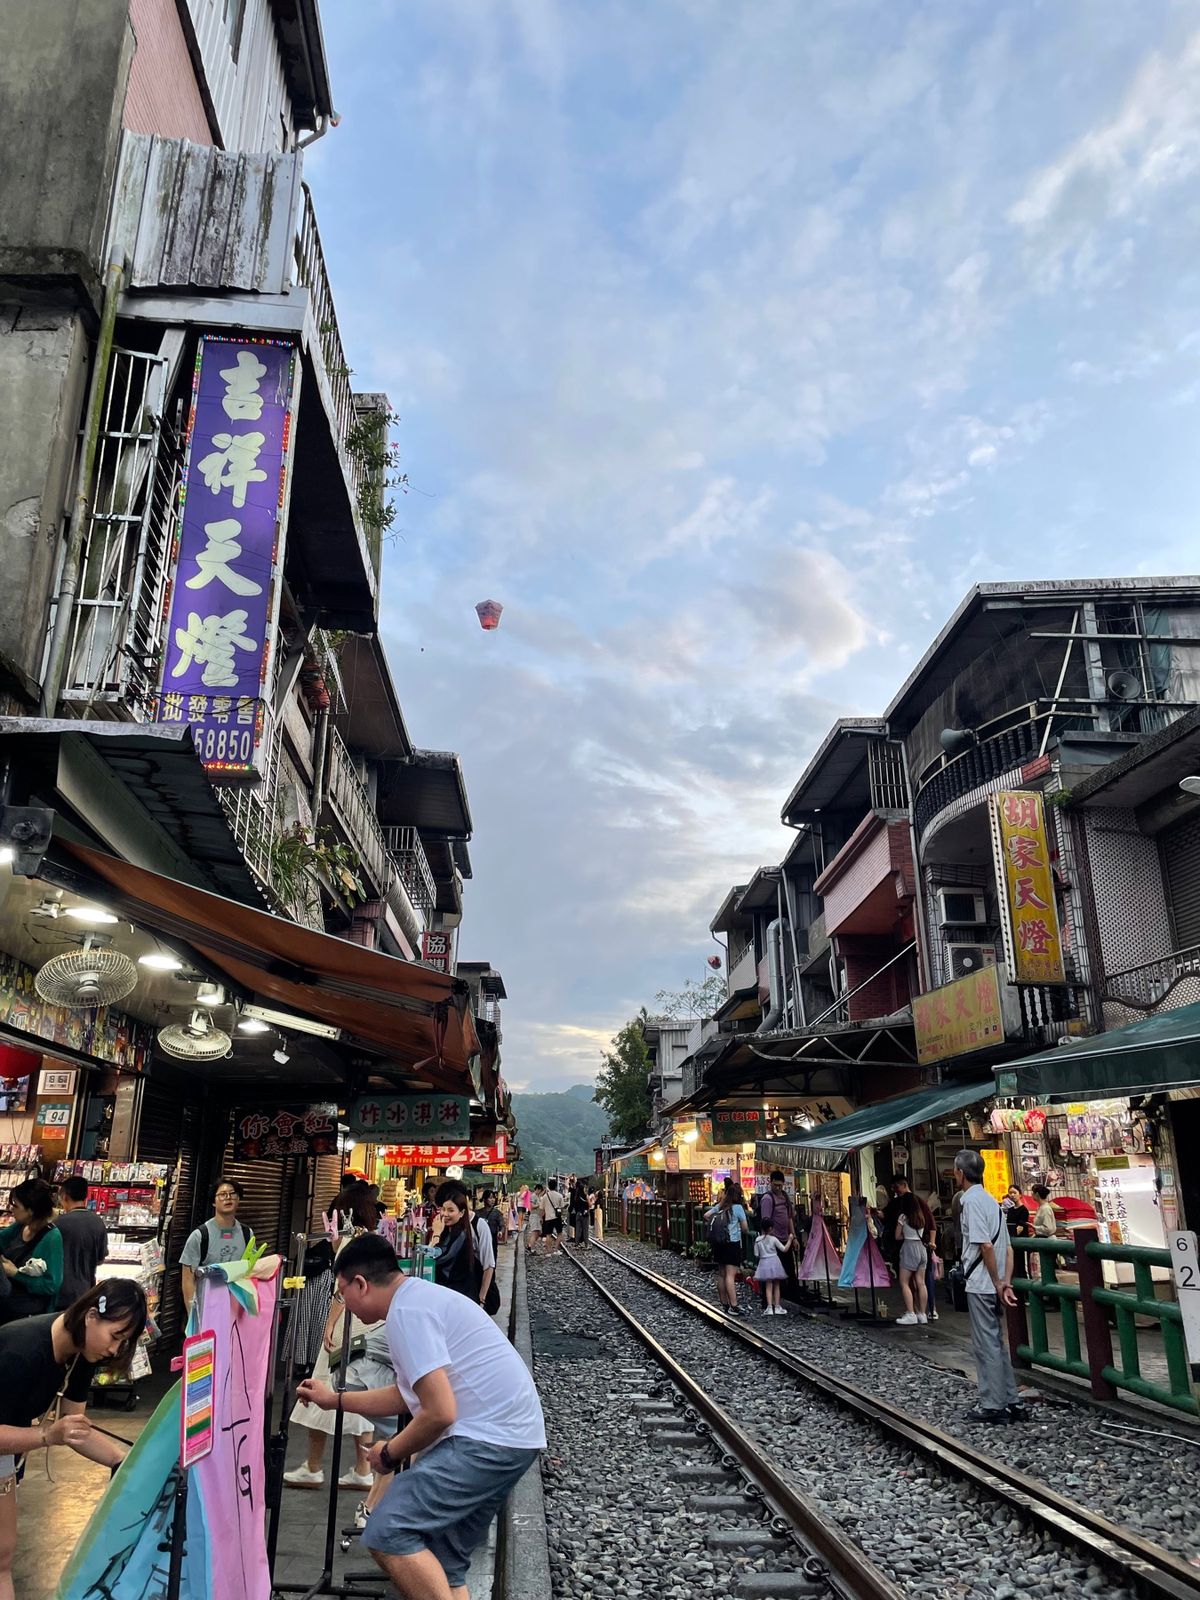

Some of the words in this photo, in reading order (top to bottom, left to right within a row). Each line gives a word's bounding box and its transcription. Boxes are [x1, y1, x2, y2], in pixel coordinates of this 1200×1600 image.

[172, 350, 267, 688] 吉祥天燈
[1003, 794, 1053, 956] 胡家天燈
[51, 1111, 65, 1123] 94
[240, 1111, 334, 1139] 你會紅
[360, 1102, 460, 1125] 炸冰淇淋
[1176, 1237, 1188, 1252] 6
[1180, 1266, 1196, 1288] 2
